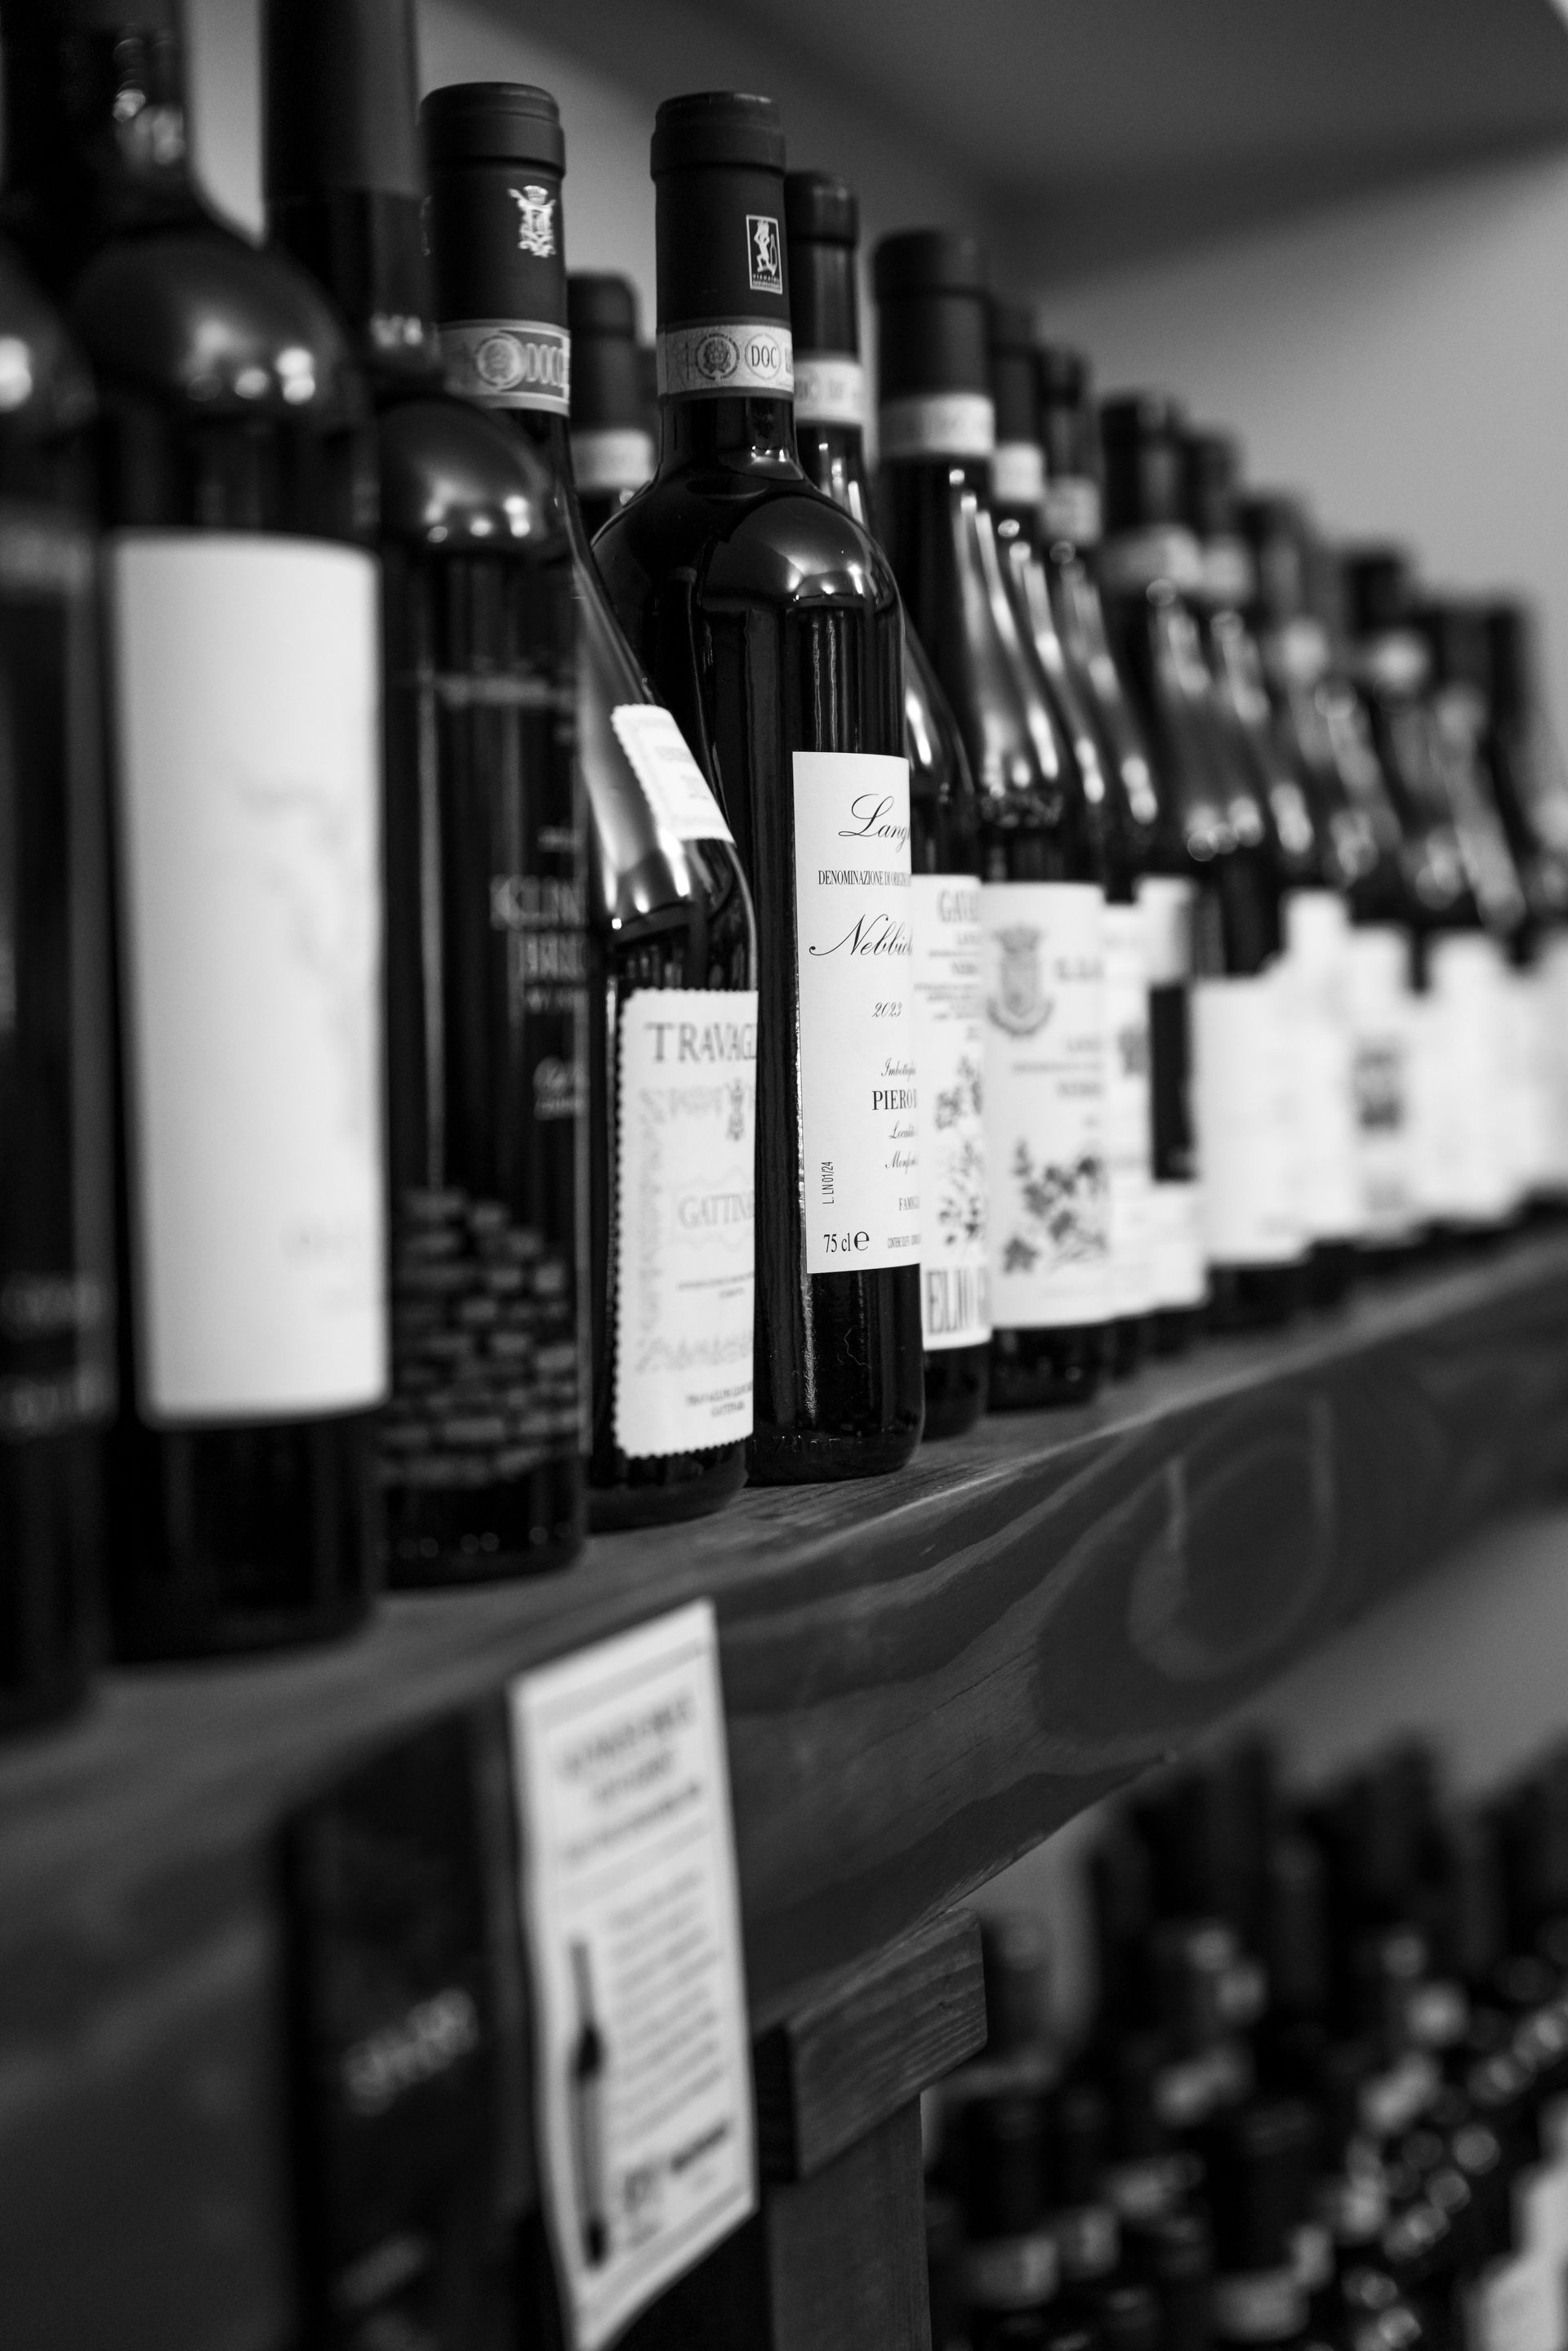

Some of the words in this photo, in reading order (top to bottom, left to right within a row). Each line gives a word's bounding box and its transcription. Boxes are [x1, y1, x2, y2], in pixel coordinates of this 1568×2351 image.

[751, 345, 777, 369] DOC
[817, 870, 884, 885] DENOMINAZIONE
[871, 1000, 903, 1017] 2023
[823, 1233, 838, 1253] 75
[841, 1232, 851, 1252] cl
